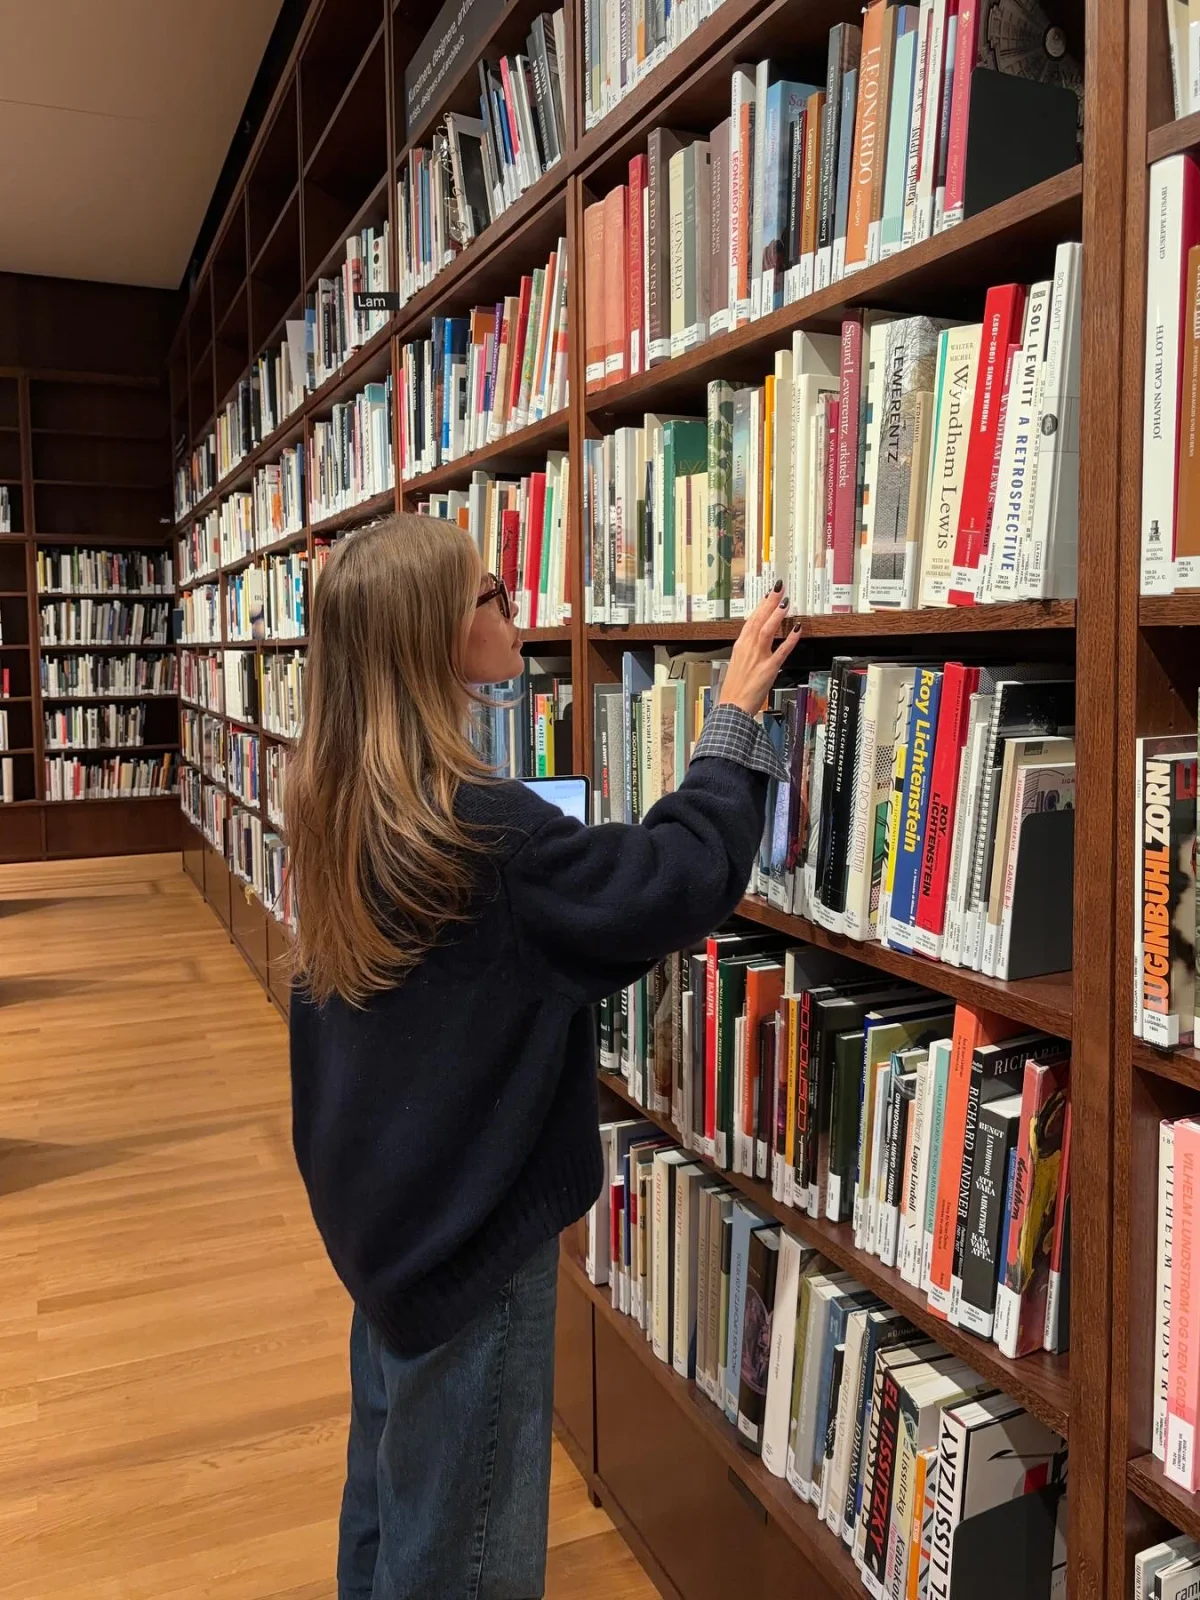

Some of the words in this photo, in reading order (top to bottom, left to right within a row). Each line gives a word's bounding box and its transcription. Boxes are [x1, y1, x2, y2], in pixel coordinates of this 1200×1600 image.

[538, 55, 548, 95] LANVIN
[826, 105, 834, 151] TECHNICAL
[858, 44, 881, 185] LEONARDO
[806, 128, 815, 171] Leonardo
[649, 146, 657, 230] LEONARDO
[731, 150, 740, 214] LEONARDO
[804, 188, 813, 211] Vinci
[806, 174, 813, 187] da
[905, 164, 918, 207] Stanislas
[630, 181, 642, 264] UNKNOWN
[730, 218, 738, 231] DA
[1159, 215, 1167, 260] GIUSEPPE
[650, 237, 656, 256] DA
[674, 211, 684, 300] LEONARDO
[729, 235, 738, 267] VINCI
[358, 295, 386, 308] Lam
[630, 270, 641, 329] LEONAR
[1055, 271, 1066, 294] SOL
[1029, 303, 1043, 338] SOL
[1051, 295, 1064, 332] LEWITT
[843, 323, 856, 367] Sigurd
[949, 354, 972, 362] MICHEL
[950, 342, 975, 351] WALTER
[1155, 324, 1164, 357] LOTH
[983, 364, 994, 389] LEWIS
[1020, 343, 1039, 408] LEWITT
[1154, 358, 1163, 391] CARL
[841, 369, 855, 439] Lewerentz,
[887, 344, 905, 464] LEWERENTZ
[946, 364, 969, 480] Wyndham
[979, 390, 992, 433] WYNDHAM
[1018, 416, 1030, 426] A
[1153, 392, 1163, 440] JOHANN
[994, 392, 1010, 461] WYNDHAM
[827, 454, 835, 518] LEWANDOWSKY
[838, 441, 850, 488] arkitekt
[988, 464, 1000, 503] LEWIS
[937, 485, 958, 550] Lewis
[1001, 436, 1028, 573] RETROSPECTIVE
[983, 522, 992, 549] ARTIST
[917, 669, 935, 716] Roy
[825, 678, 838, 764] LICHTENSTEIN
[842, 705, 850, 725] ROY
[865, 719, 876, 734] THE
[836, 729, 847, 793] LICHTENSTEIN
[863, 737, 874, 772] PRINTS
[861, 795, 870, 814] ROY
[862, 776, 871, 792] OF
[904, 720, 932, 853] Lichtenstein
[1013, 779, 1023, 814] SIGMUND
[1144, 761, 1169, 846] ZORN
[890, 811, 898, 852] LICHTENSTEIN
[938, 803, 949, 834] ROY
[1010, 815, 1020, 852] ASMERVIK
[856, 816, 868, 874] LICHTENSTEIN
[922, 791, 941, 897] LICHTENSTEIN
[1005, 863, 1015, 893] DANIEL
[1143, 846, 1169, 1012] LUGINBÜHL
[706, 954, 715, 979] Lilio
[705, 981, 715, 1021] Andrea
[797, 990, 811, 1133] COSMOCIDE
[915, 1075, 927, 1110] Thomas
[892, 1091, 902, 1140] WINOGRAND
[934, 1108, 943, 1143] LINDGREN
[964, 1086, 980, 1150] RICHARD
[978, 1121, 1005, 1138] BENGT
[889, 1141, 898, 1168] GARRY
[908, 1145, 921, 1172] Lage
[983, 1134, 997, 1176] LINDROOS
[907, 1173, 921, 1212] Lindell
[957, 1155, 975, 1218] LINDNER
[1181, 1152, 1194, 1216] VILHELM
[977, 1192, 990, 1236] ARKITEKT
[1164, 1164, 1175, 1268] VILHELM
[1179, 1219, 1192, 1314] LUNDSTRØM
[863, 1326, 873, 1362] RÜDIGER
[1178, 1315, 1189, 1339] OG
[1177, 1341, 1188, 1372] DEN
[885, 1379, 899, 1408] EL
[1174, 1375, 1187, 1418] GODE
[850, 1421, 864, 1482] JOHANN
[846, 1484, 859, 1516] LISS
[871, 1413, 895, 1557] LISSITZKY
[896, 1451, 910, 1517] Lissitzky
[930, 1419, 959, 1576] LISSITZKY
